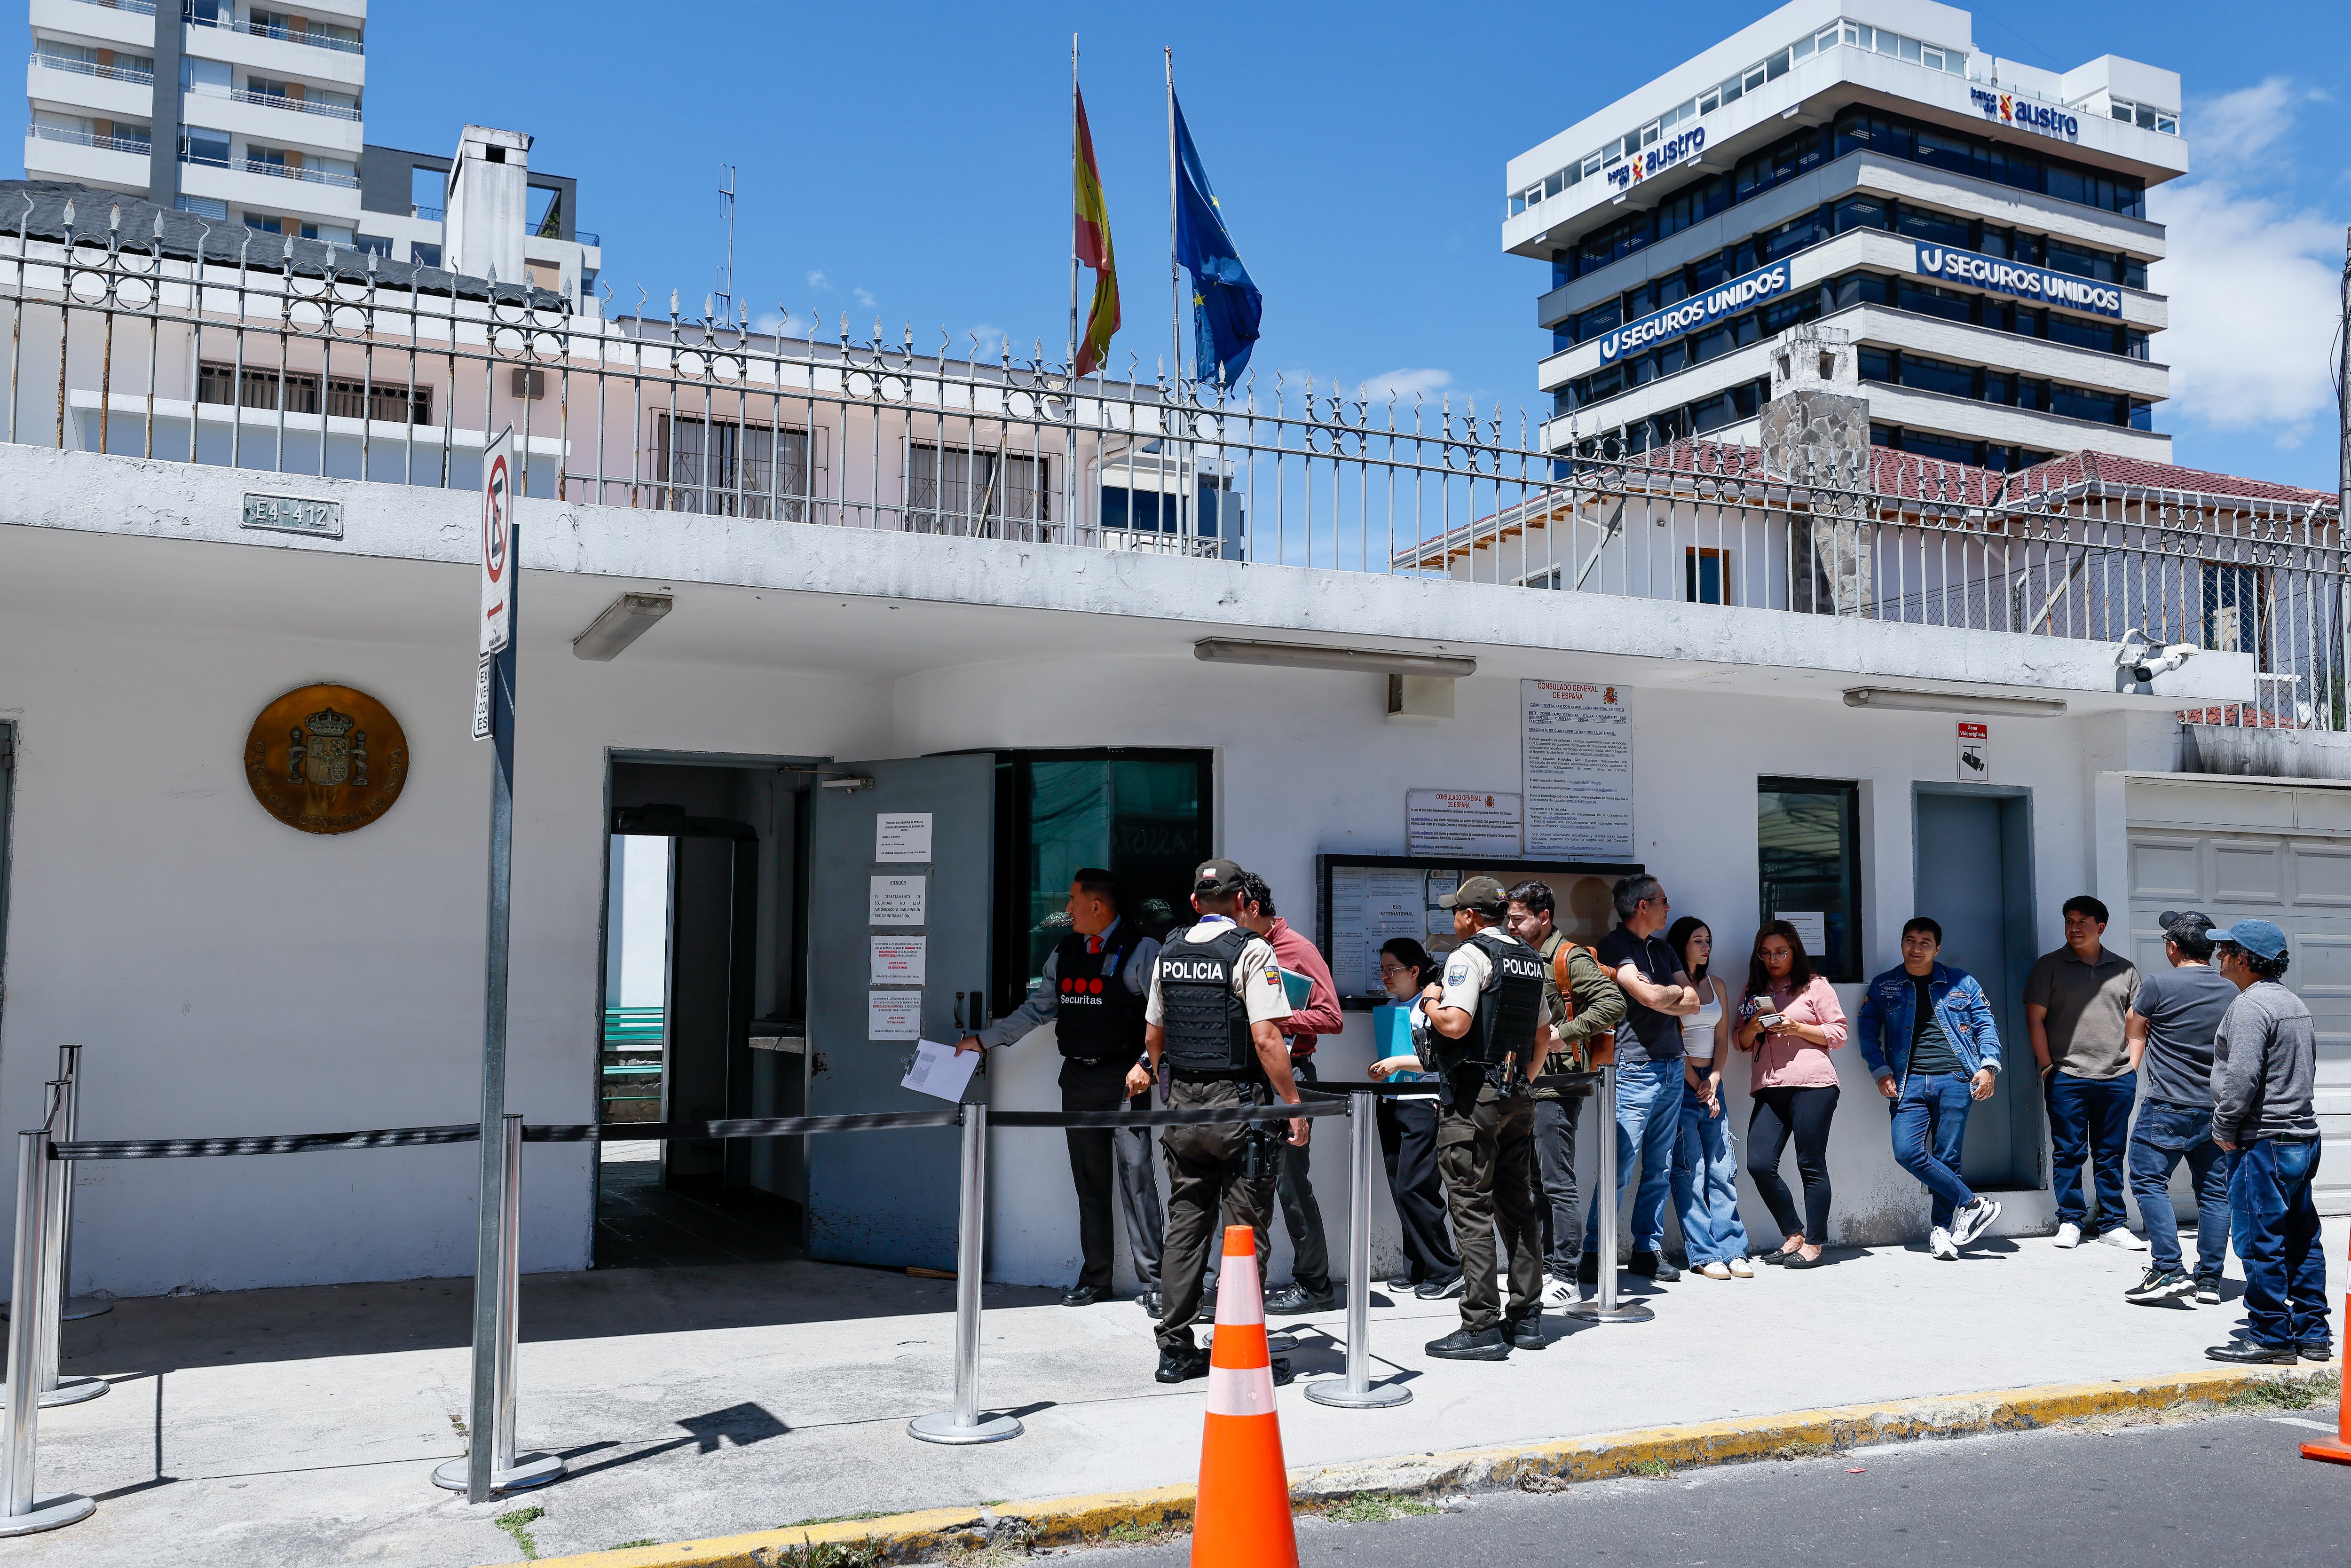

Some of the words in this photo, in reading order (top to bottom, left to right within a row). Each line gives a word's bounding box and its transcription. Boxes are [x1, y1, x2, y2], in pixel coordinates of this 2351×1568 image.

[1970, 87, 1996, 102] banco
[1983, 102, 1996, 114] del
[2015, 102, 2077, 135] austro
[1619, 172, 1629, 185] del
[1646, 127, 1704, 171] austro
[1608, 165, 1629, 181] banco
[1945, 253, 2040, 292] SEGUROS
[2043, 275, 2119, 311] UNIDOS
[1621, 301, 1704, 350] SEGUROS
[1707, 268, 1785, 314] UNIDOS
[256, 500, 327, 526] E4-412
[1163, 961, 1223, 979] POLICIA
[1503, 958, 1543, 978] POLICIA
[1061, 995, 1102, 1005] Securitas
